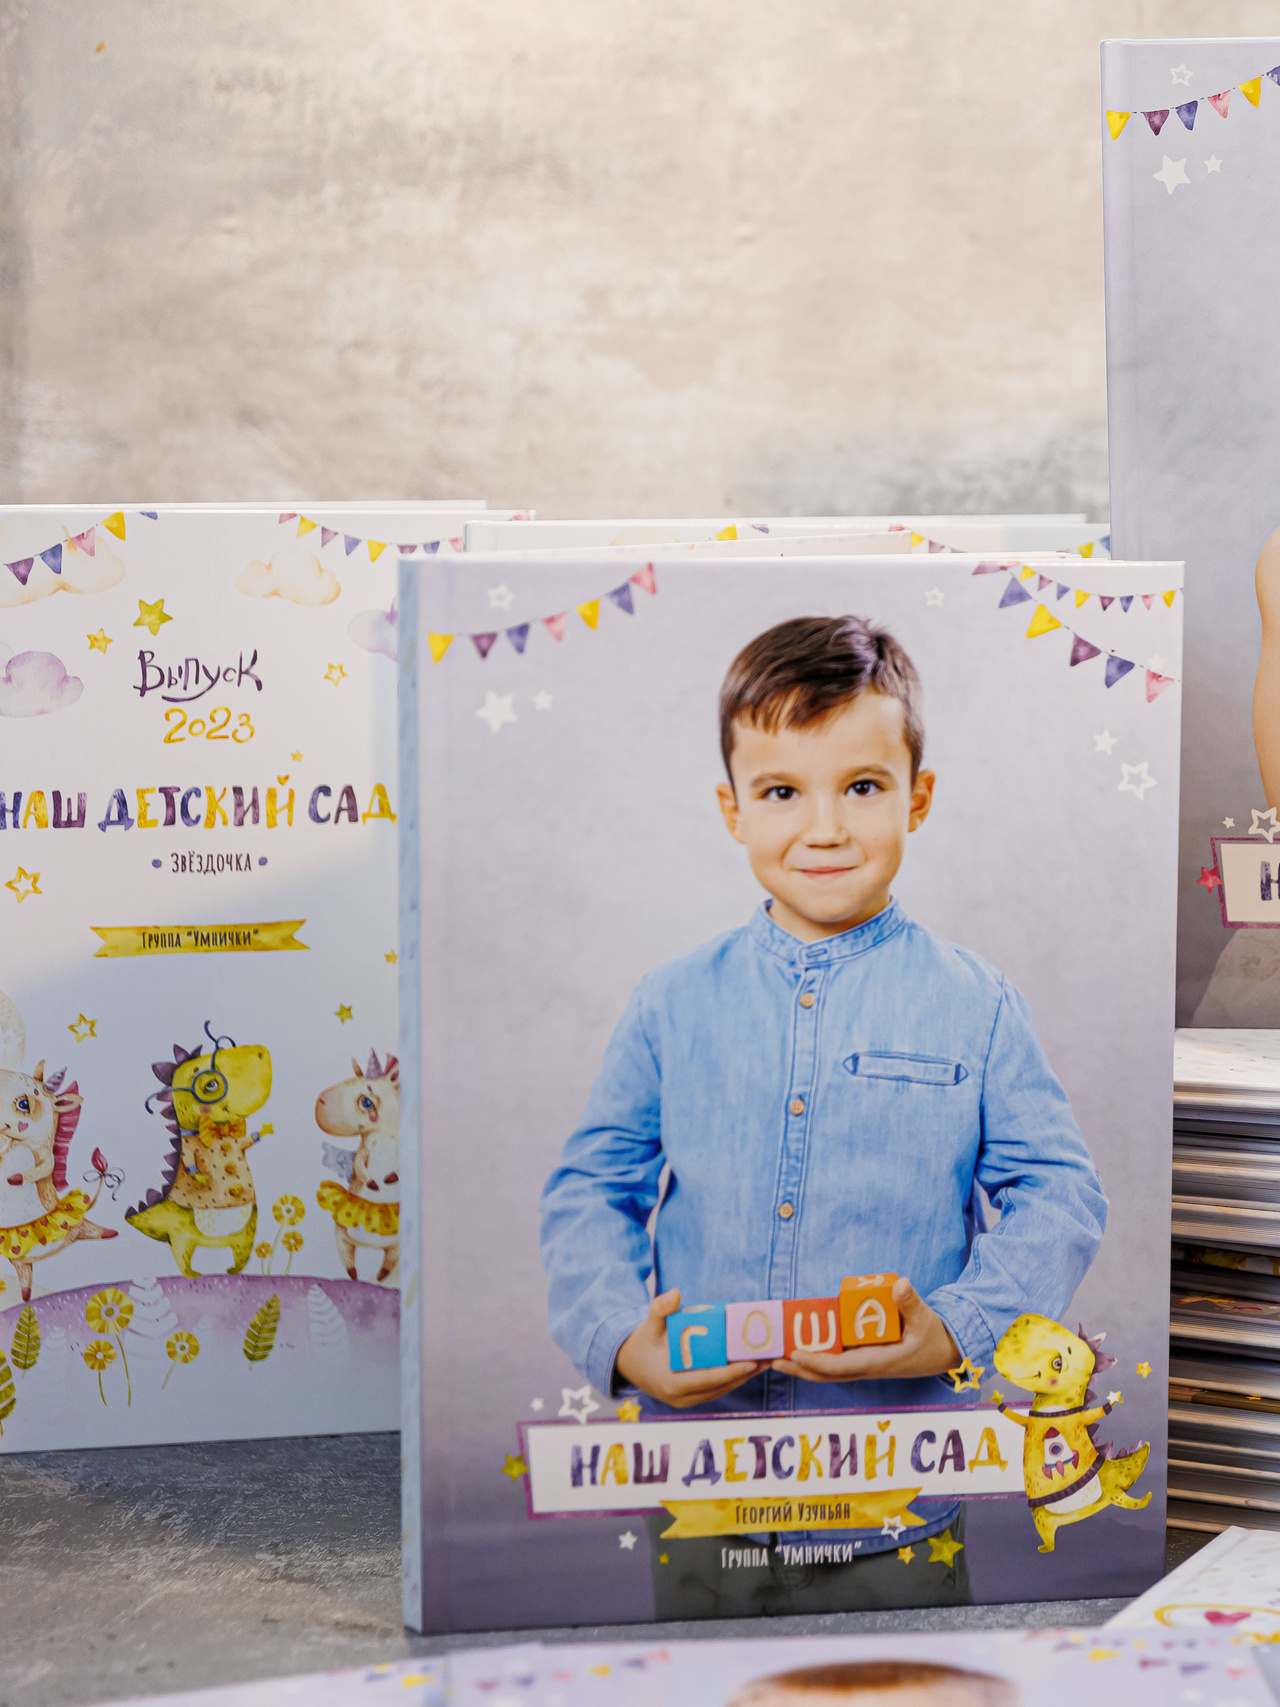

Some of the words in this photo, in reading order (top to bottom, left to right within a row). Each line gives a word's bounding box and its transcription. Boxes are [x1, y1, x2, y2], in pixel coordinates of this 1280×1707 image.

[133, 648, 263, 702] Выпуск
[163, 706, 256, 744] 2023
[0, 788, 88, 830] НАШ
[97, 774, 295, 832] ДЕТСКИЙ
[308, 782, 398, 826] САД
[570, 1441, 671, 1488] НАШ
[682, 1419, 897, 1487] ДЕТСКИЙ
[911, 1426, 1009, 1474] САД
